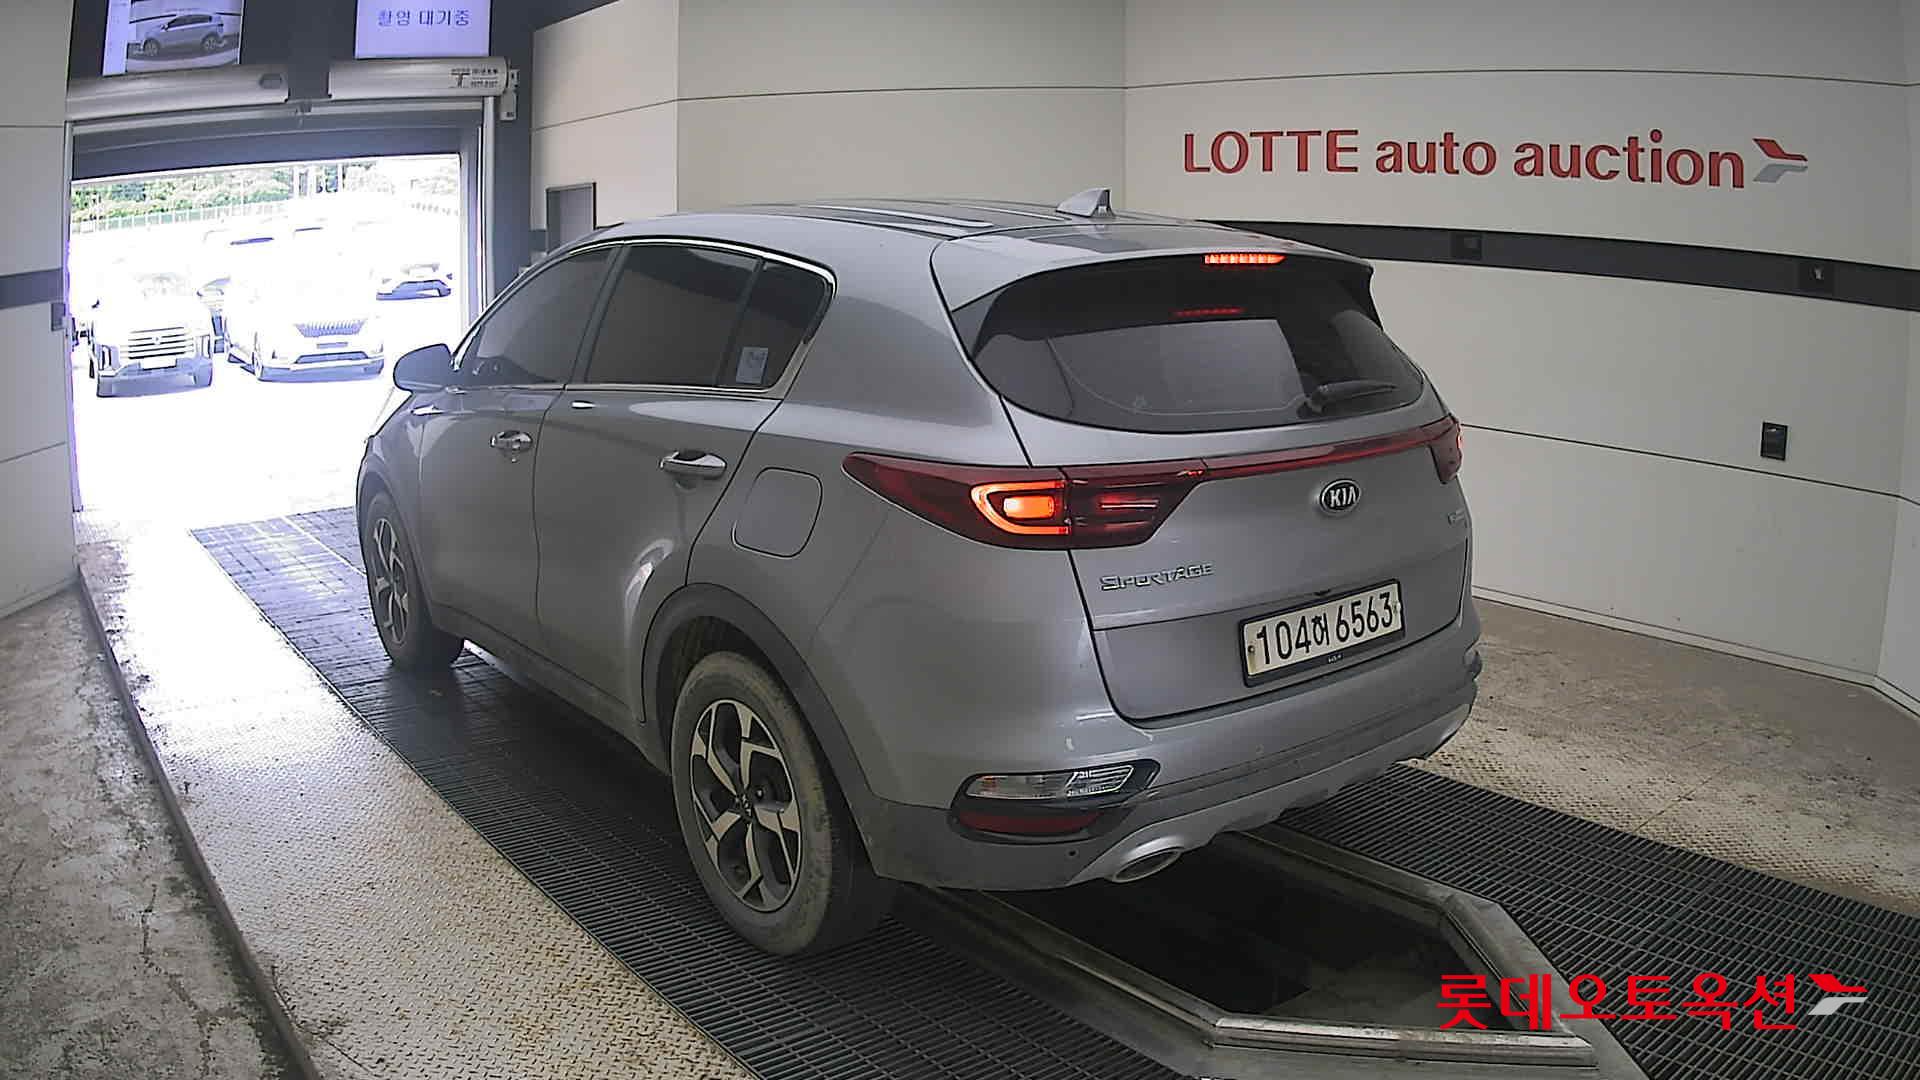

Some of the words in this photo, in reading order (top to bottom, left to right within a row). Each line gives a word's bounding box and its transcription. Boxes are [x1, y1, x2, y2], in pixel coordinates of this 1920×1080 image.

[419, 10, 469, 26] 대기중
[1184, 130, 1359, 173] LOTTE
[1375, 131, 1497, 176] auto
[1513, 129, 1745, 188] auction
[1329, 486, 1357, 508] KIA
[1100, 563, 1215, 591] SPORTAGE
